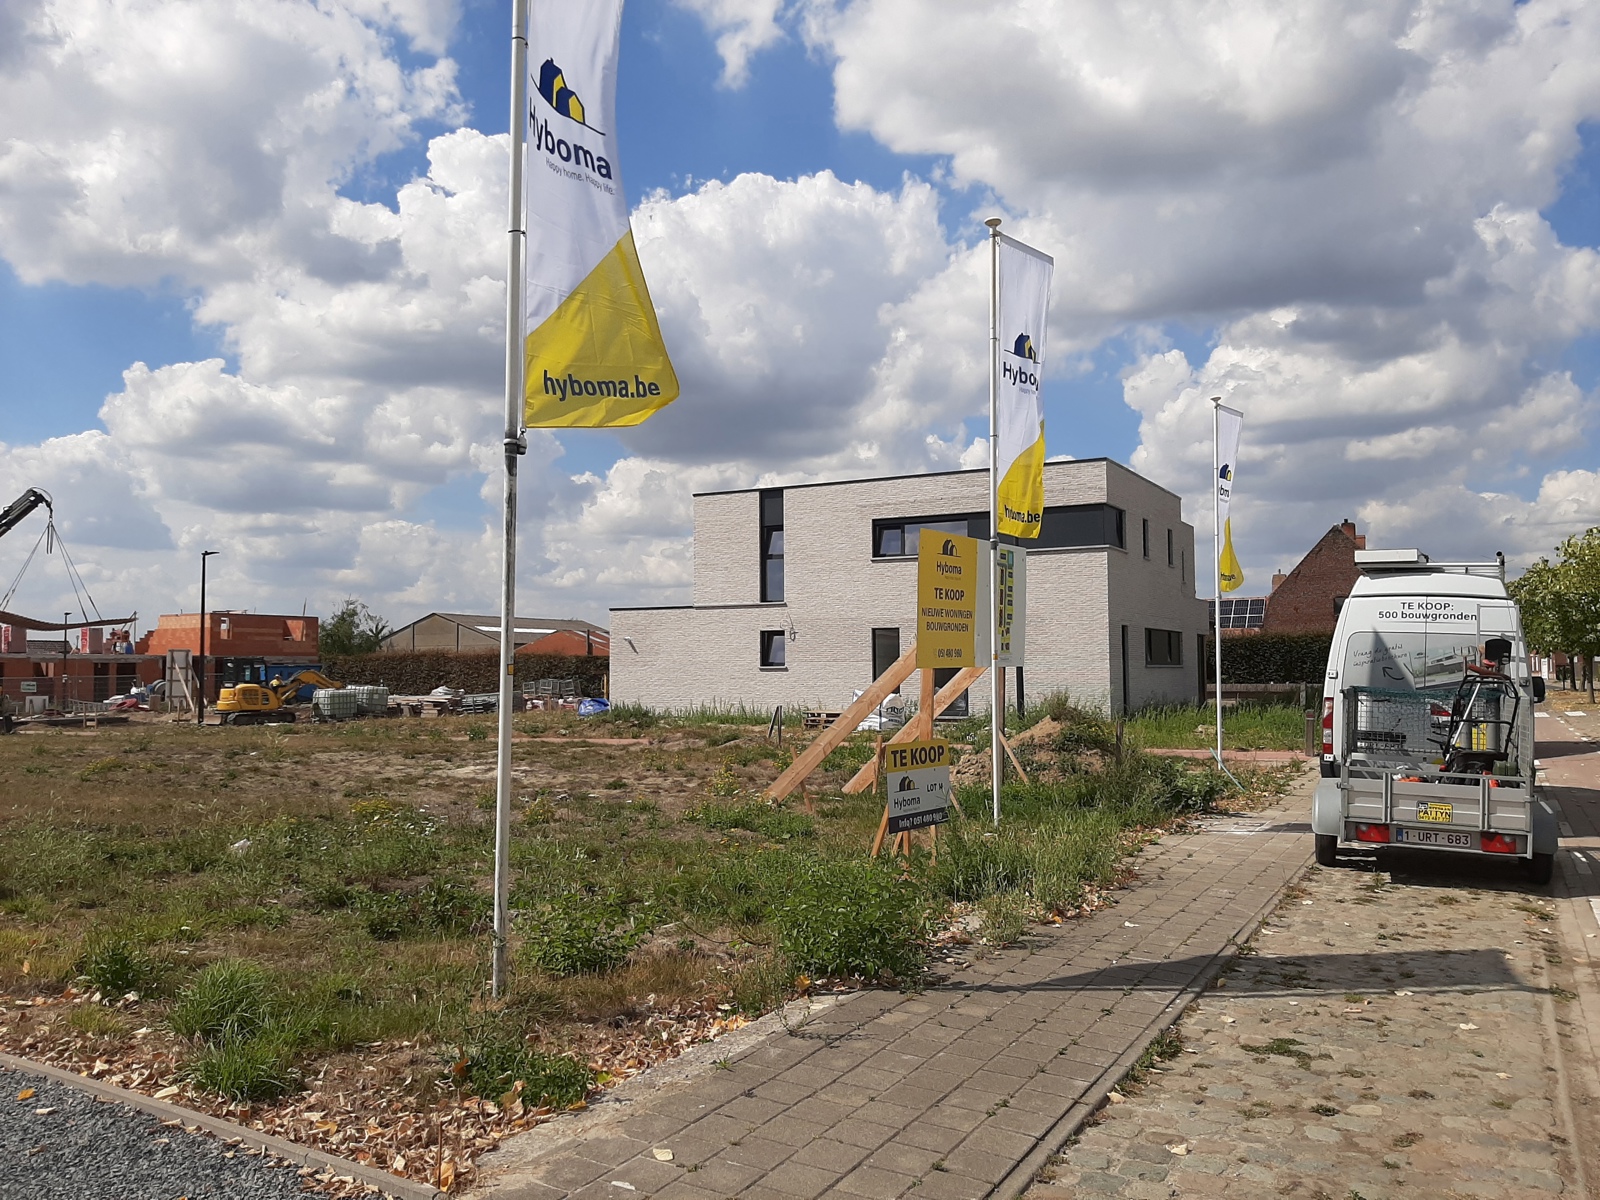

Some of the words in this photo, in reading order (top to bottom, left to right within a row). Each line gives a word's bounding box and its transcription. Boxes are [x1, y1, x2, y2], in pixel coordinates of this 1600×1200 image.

[529, 97, 613, 180] Hyboma
[545, 157, 562, 176] Happy
[585, 172, 602, 192] Happy
[543, 369, 661, 401] hyboma.be
[936, 561, 962, 575] Hyboma
[934, 587, 943, 599] TE
[945, 588, 965, 601] KOOP
[921, 607, 944, 617] NIEUWE
[945, 608, 973, 619] WONINGEN
[1400, 602, 1414, 610] TE
[1418, 602, 1454, 611] KOOP:
[1378, 611, 1398, 619] 500
[1401, 611, 1478, 621] bouwgronden
[926, 621, 969, 632] BOUWGRONDEN
[891, 749, 907, 768] TE
[911, 745, 945, 766] KOOP
[926, 783, 937, 792] LOT
[894, 797, 921, 810] Hyboma
[1419, 809, 1450, 817] PATTYN
